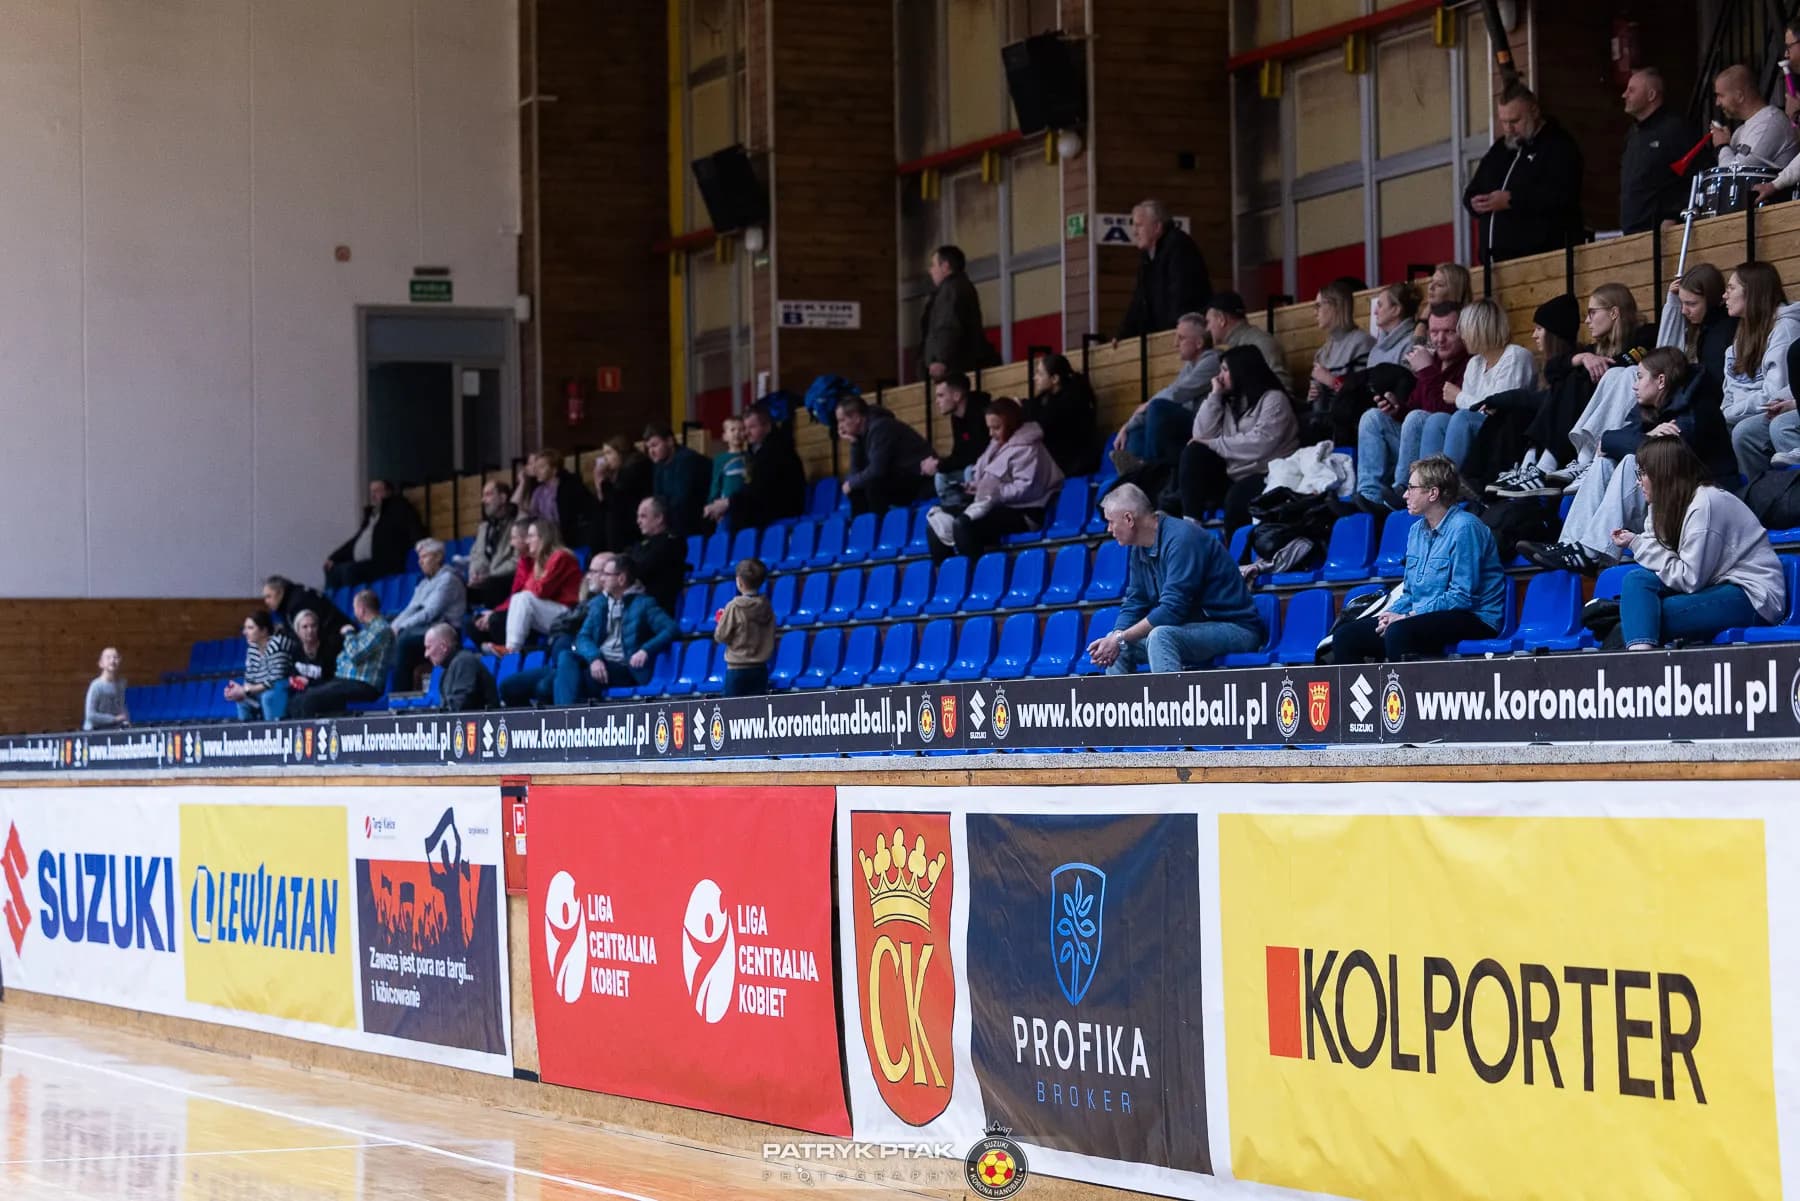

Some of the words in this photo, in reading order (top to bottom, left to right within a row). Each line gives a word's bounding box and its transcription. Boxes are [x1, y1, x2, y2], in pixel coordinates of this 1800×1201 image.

[1016, 682, 1267, 740] www.koronahandball.pl
[1310, 702, 1326, 726] CK
[1415, 660, 1777, 732] www.koronahandball.pl
[511, 713, 649, 756] www.koronahandball.pl
[729, 696, 911, 745] www.koronahandball.pl
[943, 713, 954, 734] CK
[1349, 723, 1374, 733] SUZUKI
[203, 728, 292, 763] www.koronahandball.pl
[341, 721, 450, 760] www.koronahandball.pl
[38, 849, 176, 953] SUZUKI
[218, 862, 338, 954] LEWIATAN
[587, 894, 614, 923] LIGA
[737, 904, 768, 936] LIGA
[369, 946, 399, 972] Zawsze
[398, 949, 416, 976] jest
[416, 956, 434, 979] pora
[435, 959, 446, 977] na
[447, 956, 474, 986] targi...
[589, 931, 657, 965] CENTRALNA
[738, 945, 819, 982] CENTRALNA
[375, 980, 421, 1008] kibicowanie
[591, 967, 630, 998] KOBIET
[738, 984, 787, 1018] KOBIET
[869, 935, 947, 1089] CK
[1303, 948, 1708, 1105] KOLPORTER
[1013, 1015, 1151, 1079] PROFIKA
[1037, 1081, 1132, 1114] BROKER
